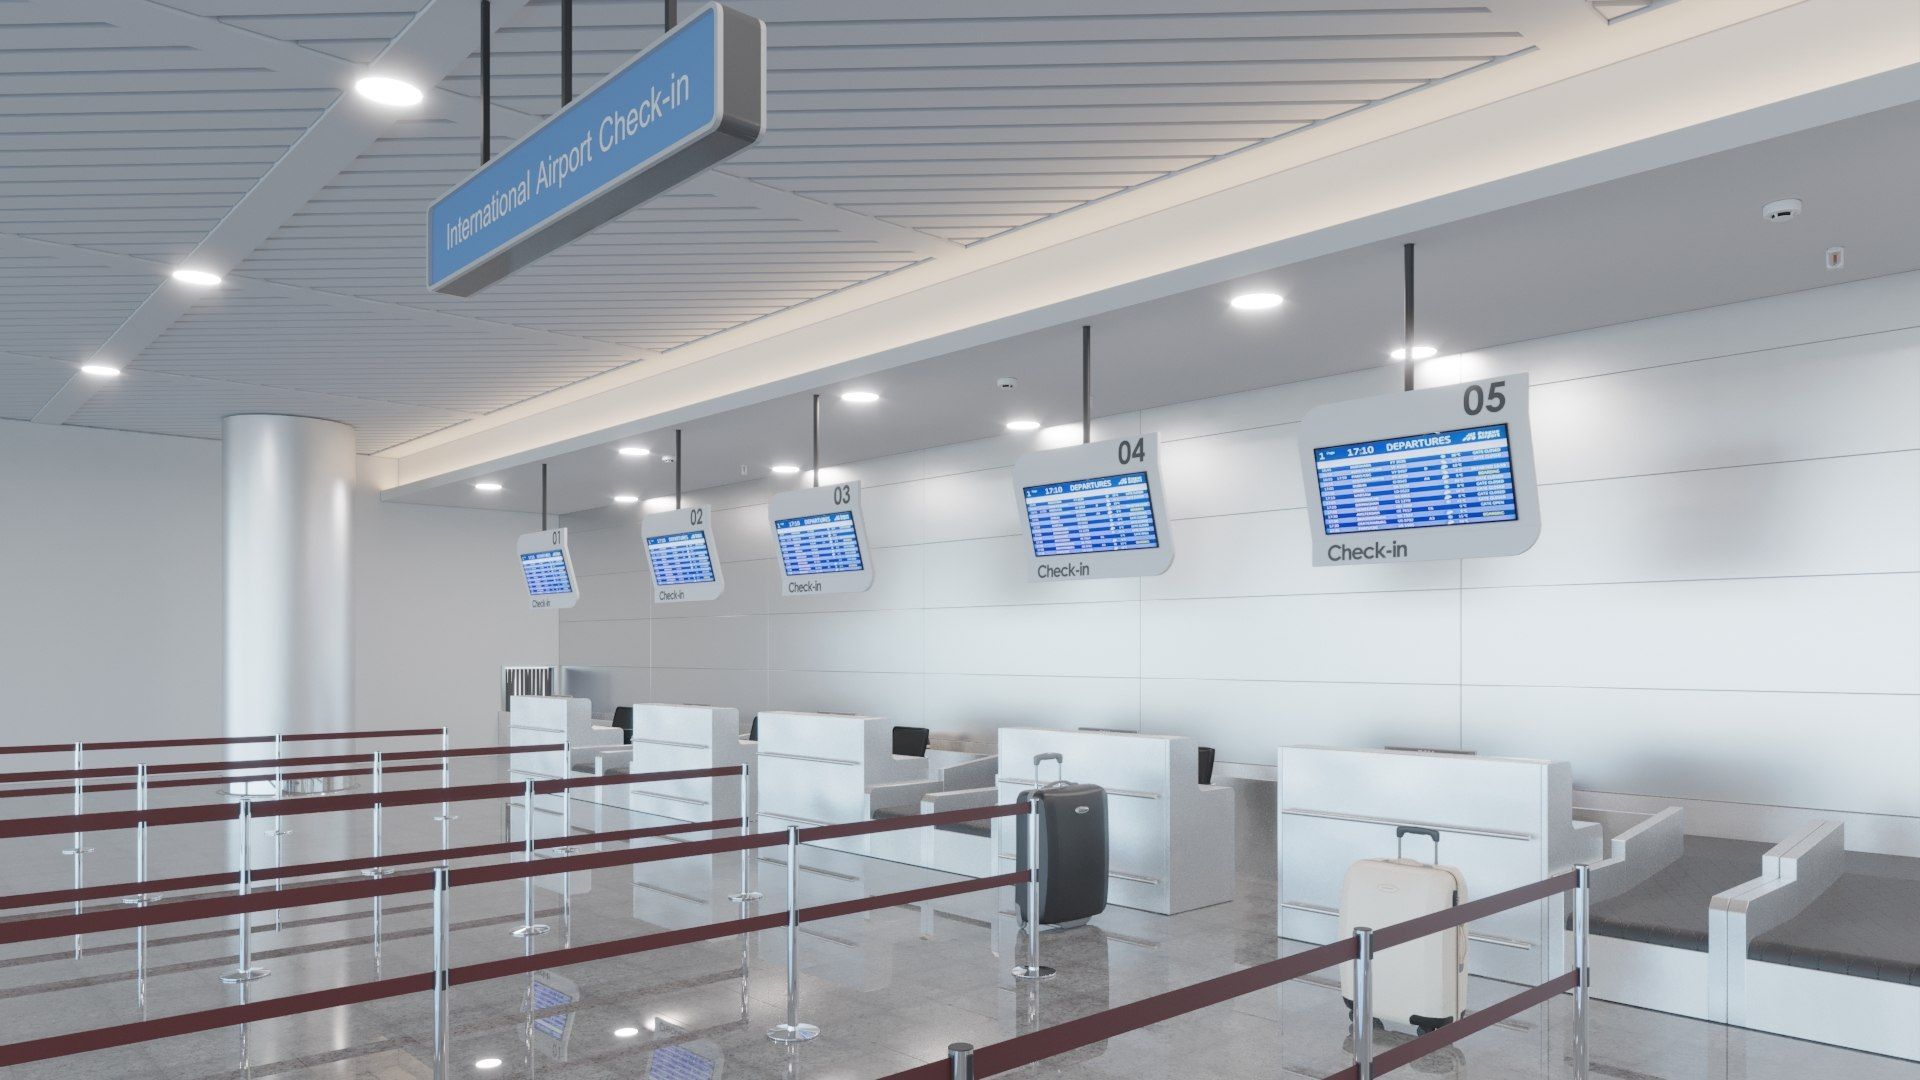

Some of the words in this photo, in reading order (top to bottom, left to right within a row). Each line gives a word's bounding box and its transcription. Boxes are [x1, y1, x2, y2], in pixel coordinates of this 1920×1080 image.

[446, 169, 530, 250] International
[536, 128, 593, 195] Airport
[599, 72, 690, 153] Check-in
[1463, 380, 1506, 416] 05
[1118, 437, 1145, 465] 04
[1347, 445, 1374, 457] 17:10
[1386, 435, 1451, 451] DEPARTURES
[834, 485, 851, 505] 03
[1070, 479, 1112, 492] DEPARTURES
[690, 508, 703, 526] 02
[552, 530, 561, 545] 01
[1328, 541, 1408, 562] Check-in
[1037, 562, 1090, 579] Check-in
[659, 590, 685, 601] Check-in
[788, 580, 822, 593] Check-in
